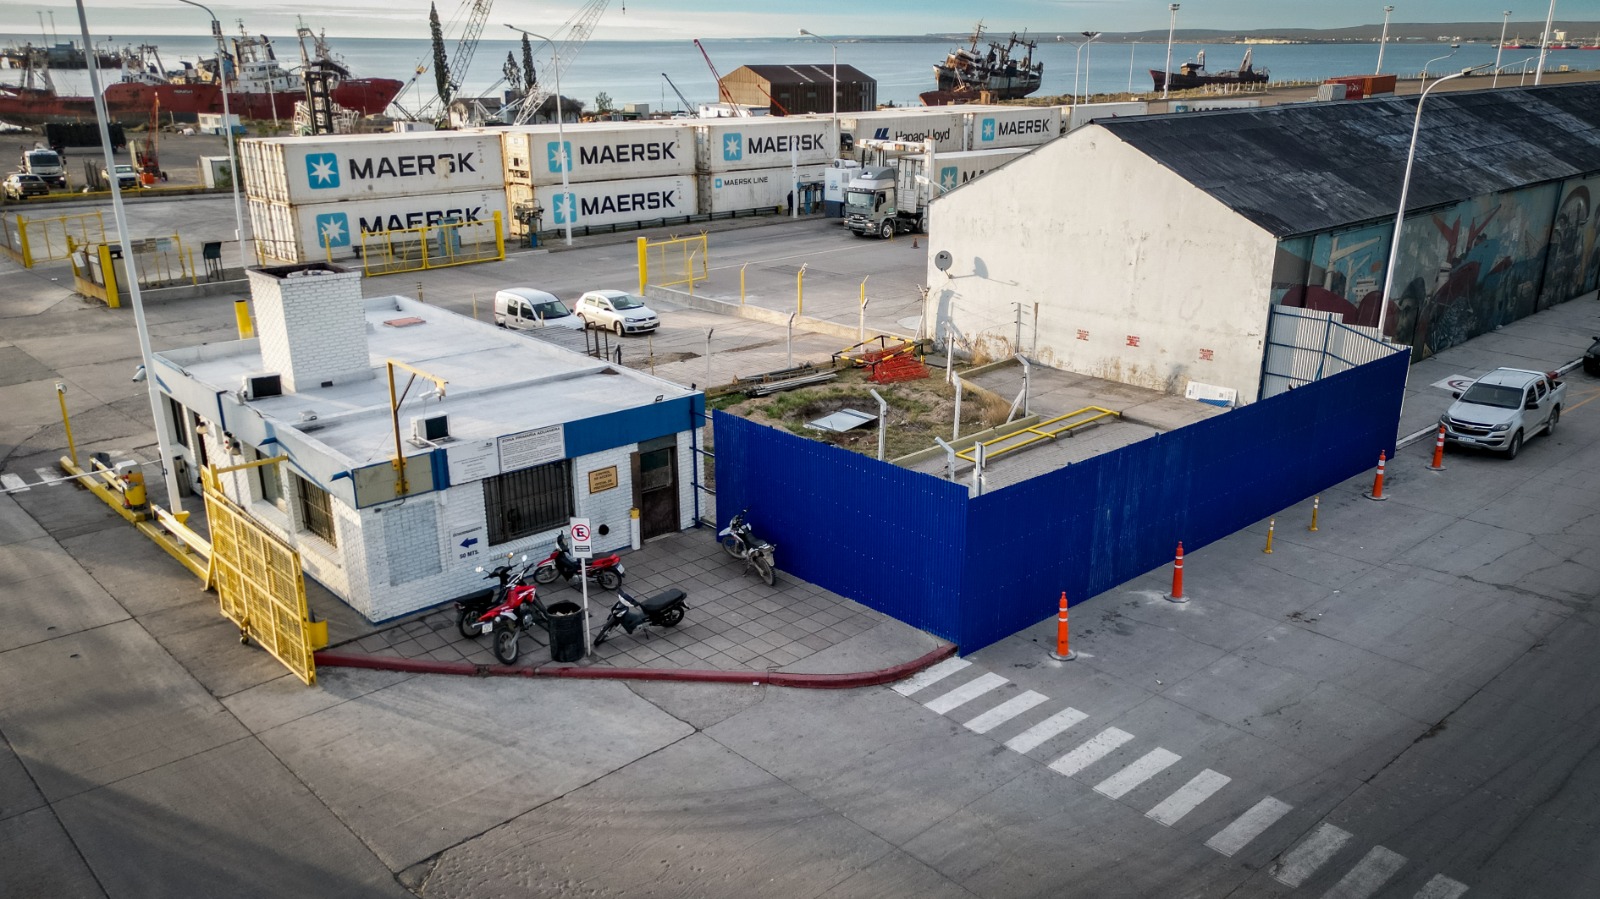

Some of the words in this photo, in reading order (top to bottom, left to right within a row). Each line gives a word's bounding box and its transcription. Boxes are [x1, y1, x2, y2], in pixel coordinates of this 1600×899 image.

[895, 127, 951, 143] Hapag-Lloyd
[998, 118, 1050, 136] MAERSK
[580, 141, 676, 165] MAERSK
[748, 133, 825, 154] MAERSK
[724, 177, 752, 186] MAERSK
[753, 176, 769, 184] LINE
[581, 190, 676, 216] MAERSK
